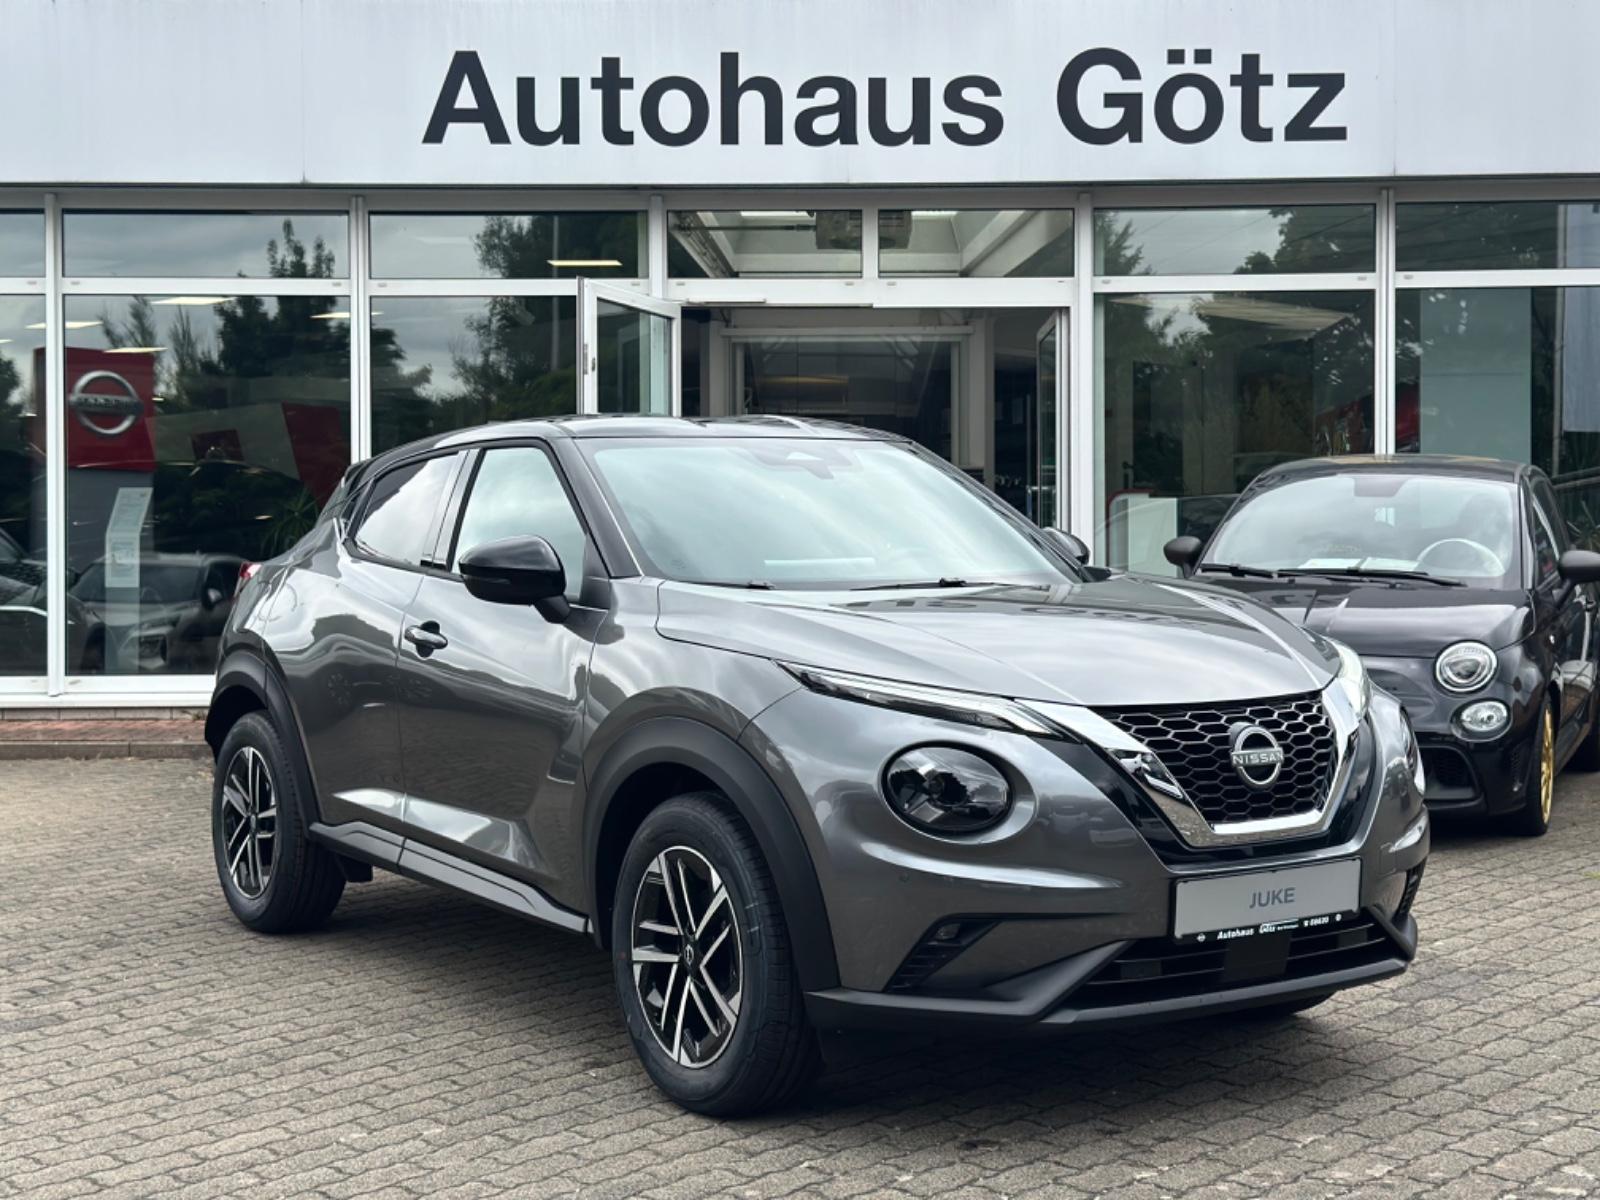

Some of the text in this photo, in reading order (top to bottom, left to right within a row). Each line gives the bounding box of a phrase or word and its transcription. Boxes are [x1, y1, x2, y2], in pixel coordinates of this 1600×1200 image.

[422, 47, 1348, 147] Autohaus Götz
[1232, 752, 1283, 765] NISSAN
[1249, 887, 1296, 909] JUKE
[1217, 928, 1254, 940] Autohaus
